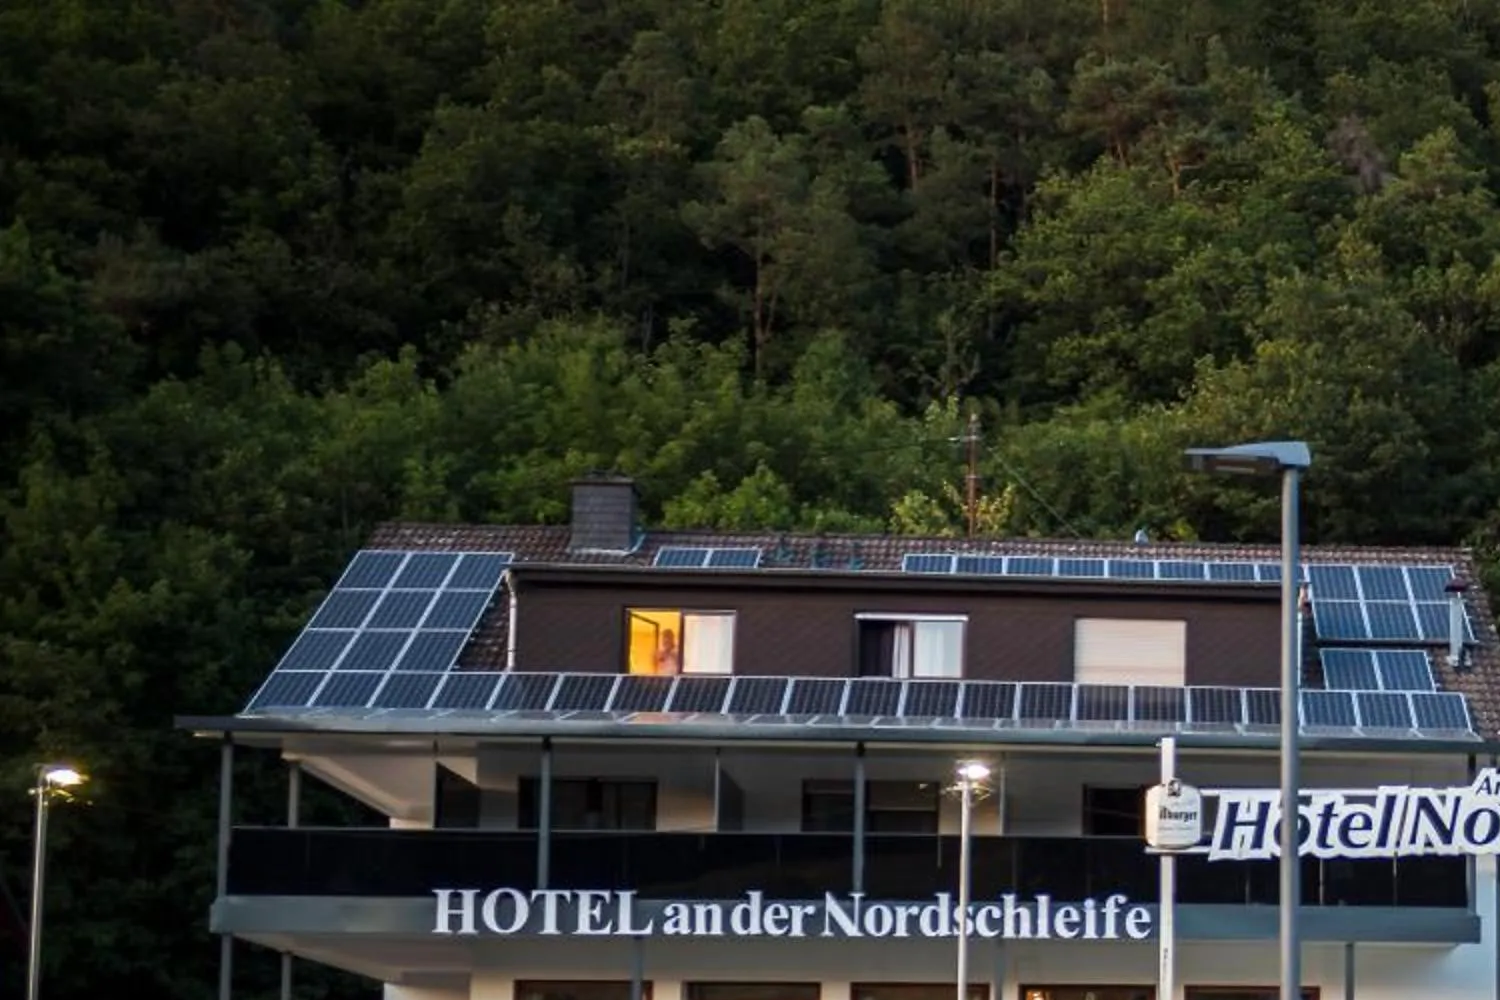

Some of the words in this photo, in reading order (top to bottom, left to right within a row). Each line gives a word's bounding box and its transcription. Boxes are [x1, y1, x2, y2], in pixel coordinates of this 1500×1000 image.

[431, 887, 654, 935] HOTEL
[663, 902, 724, 936] an
[730, 890, 816, 937] der
[821, 890, 1152, 939] Nordschleife
